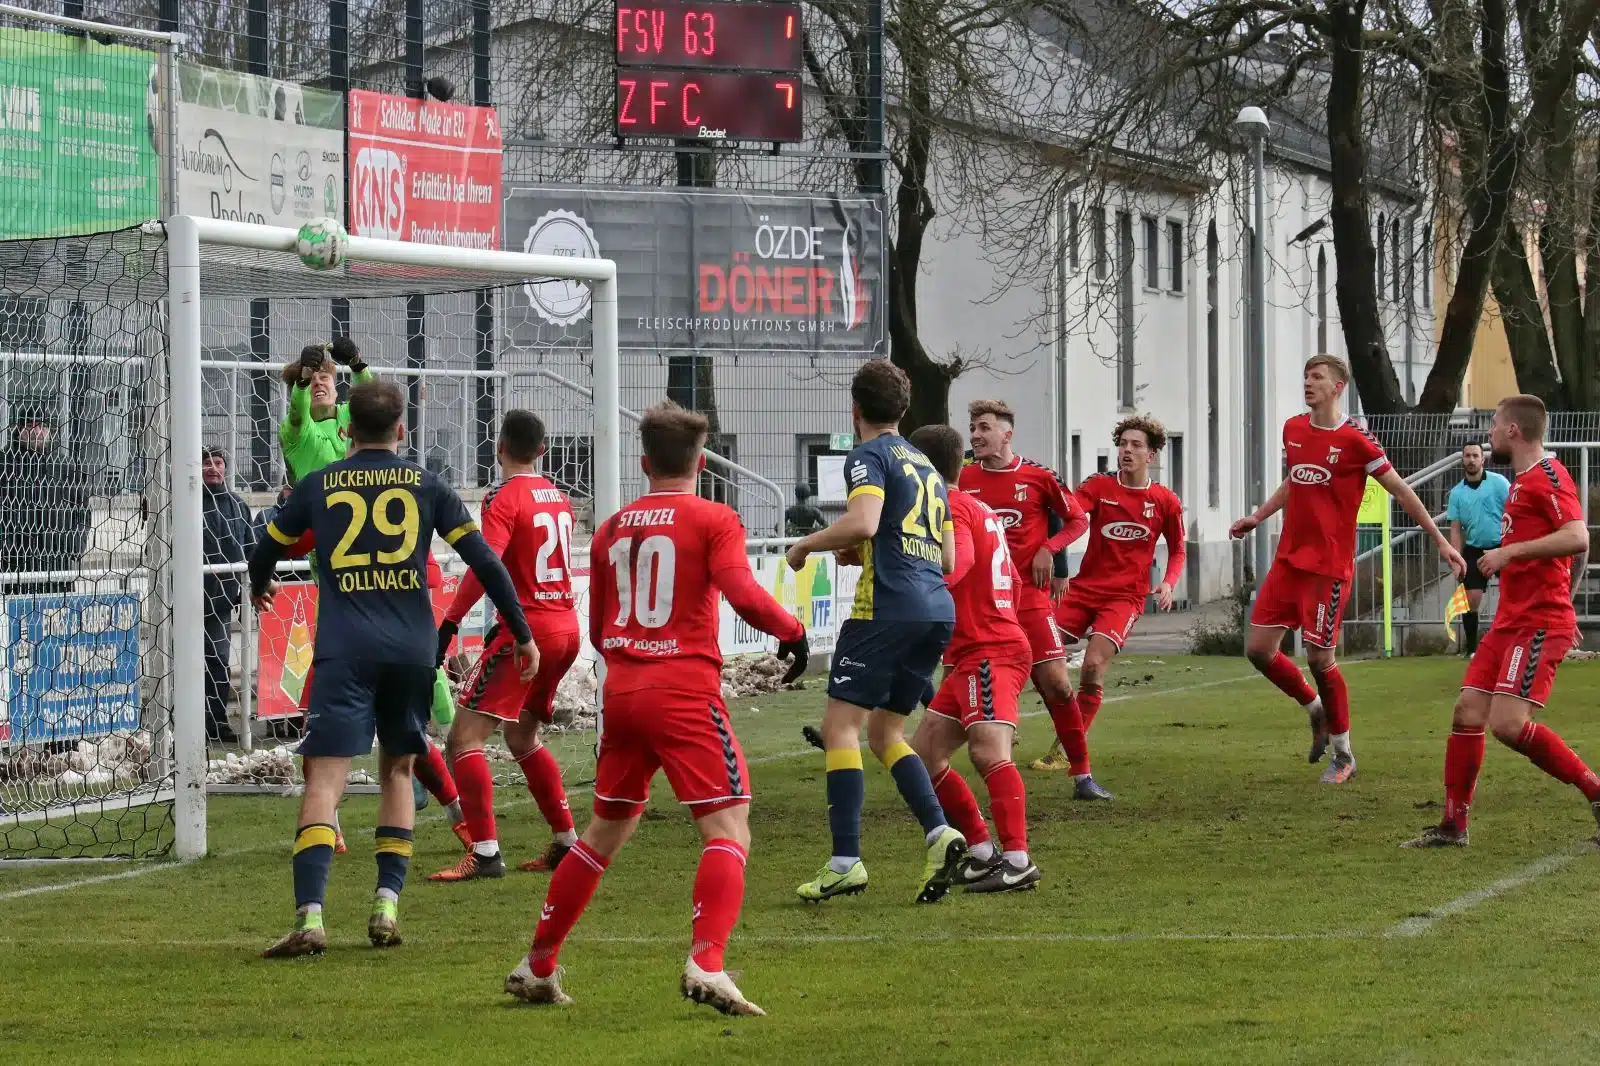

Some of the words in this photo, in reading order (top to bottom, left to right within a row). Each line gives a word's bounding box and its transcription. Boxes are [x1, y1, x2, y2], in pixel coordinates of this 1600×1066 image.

[618, 8, 665, 54] FSV
[683, 11, 716, 55] 63
[785, 14, 793, 40] 1
[775, 83, 793, 109] 7
[418, 105, 441, 135] Made
[443, 112, 452, 136] in
[698, 125, 727, 139] Bodet
[356, 164, 403, 232] KNS
[412, 171, 451, 202] Erhältlich
[467, 176, 492, 204] Ihrem
[754, 215, 825, 261] ÖZDE
[699, 251, 833, 315] DÖNER
[638, 317, 792, 334] FLEISCHPRODUKTIONS
[323, 467, 422, 491] LUCKENWALDE
[618, 508, 676, 528] STENZEL
[901, 462, 946, 544] 26
[325, 487, 420, 570] 29
[532, 511, 573, 586] 20
[608, 535, 676, 629] 10
